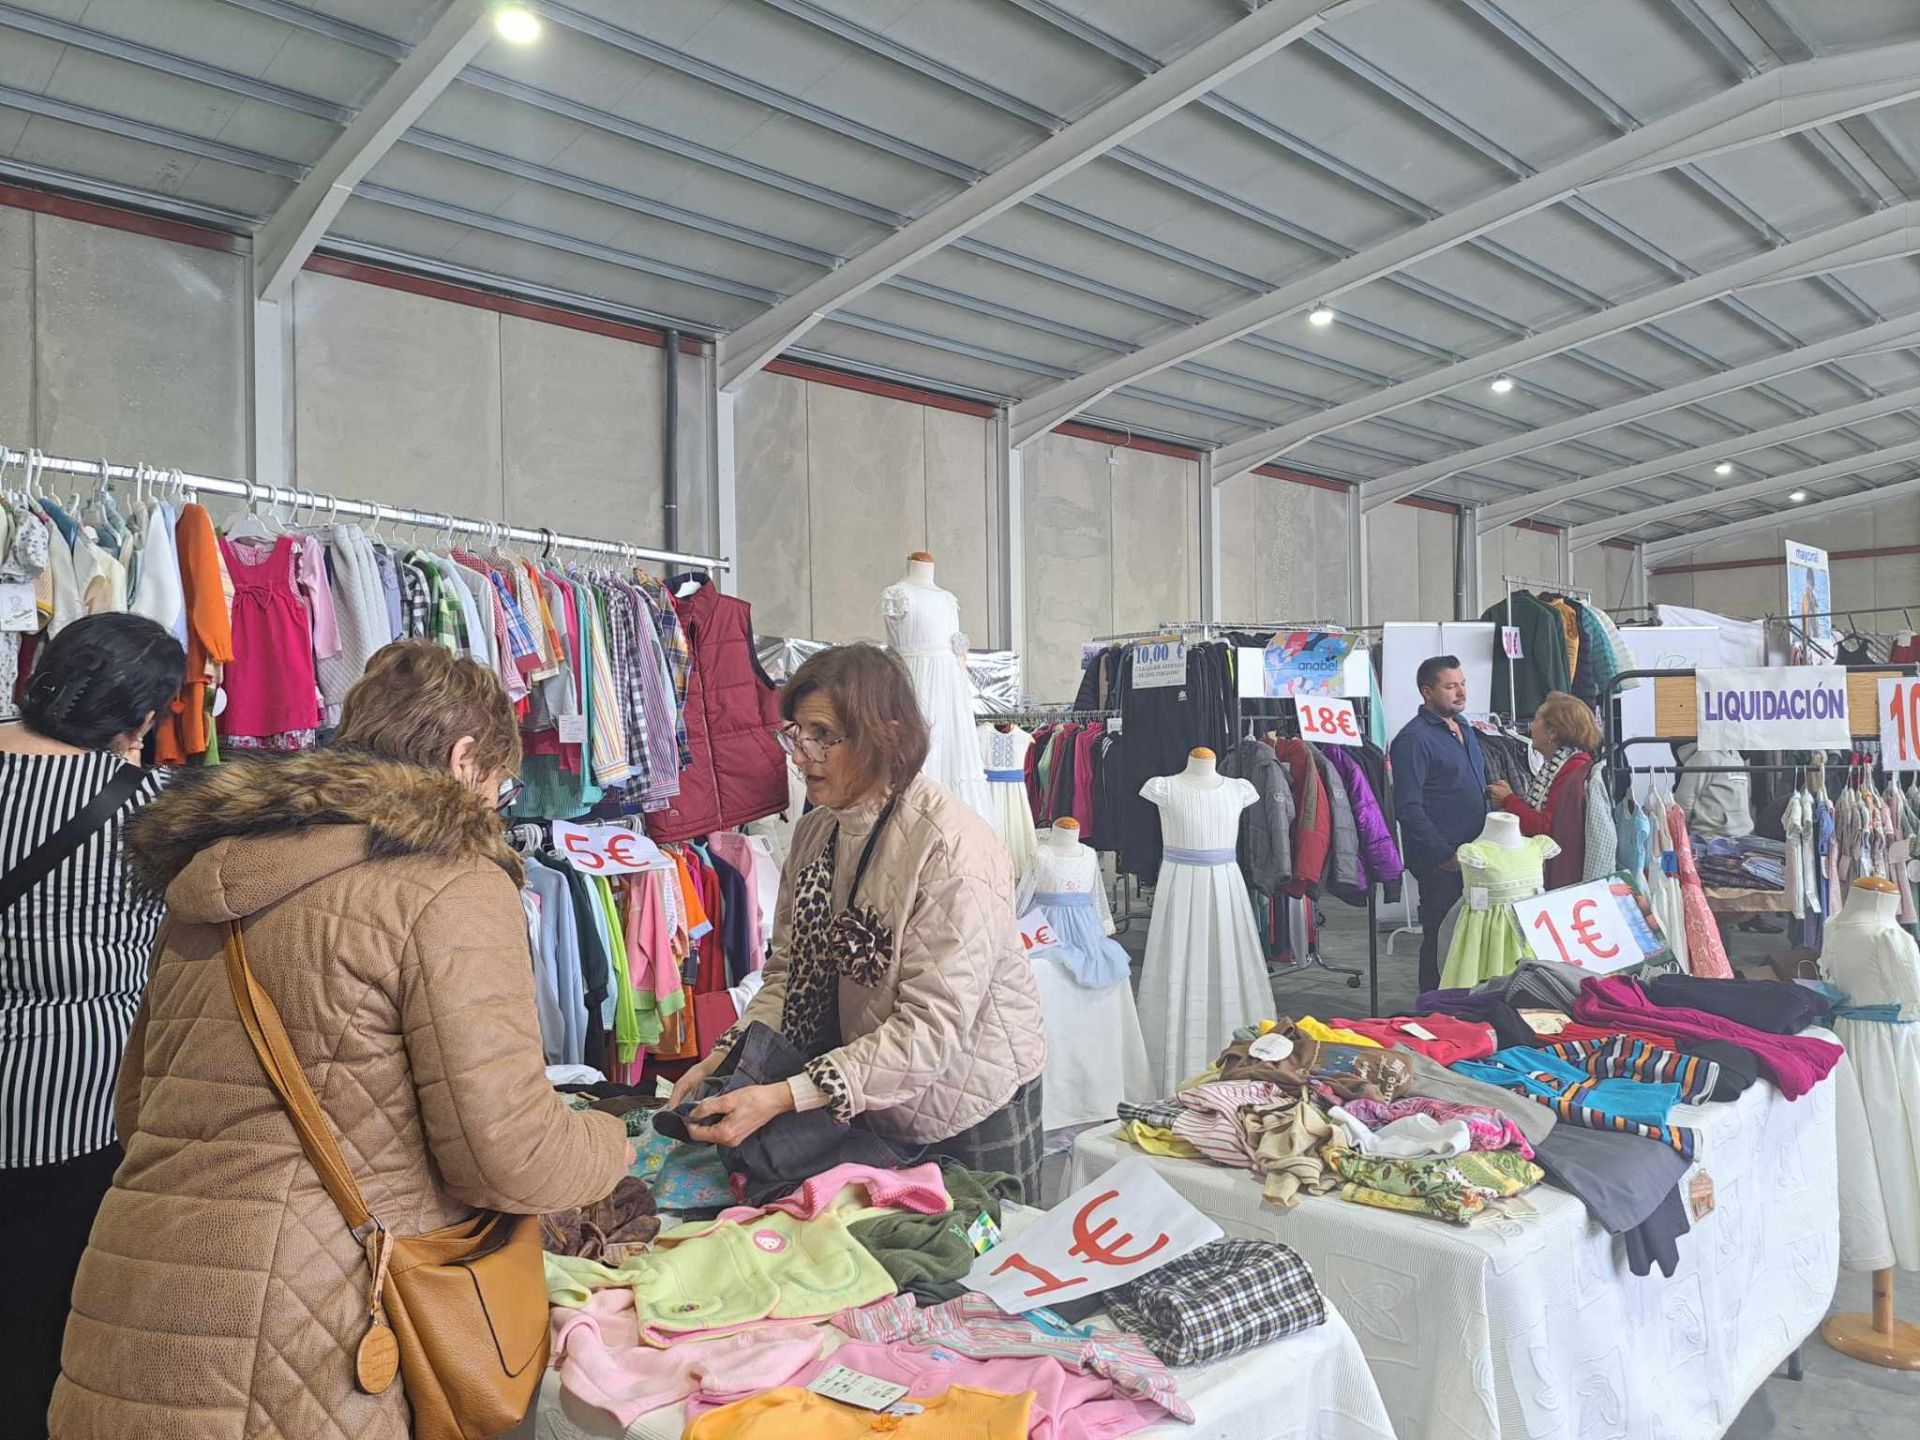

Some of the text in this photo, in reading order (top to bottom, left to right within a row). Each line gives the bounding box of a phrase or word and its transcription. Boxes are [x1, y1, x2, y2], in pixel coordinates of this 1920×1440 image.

[1135, 643, 1169, 665] 10,00
[1704, 682, 1845, 723] LIQUIDACIÓN
[1300, 704, 1357, 738] 18€
